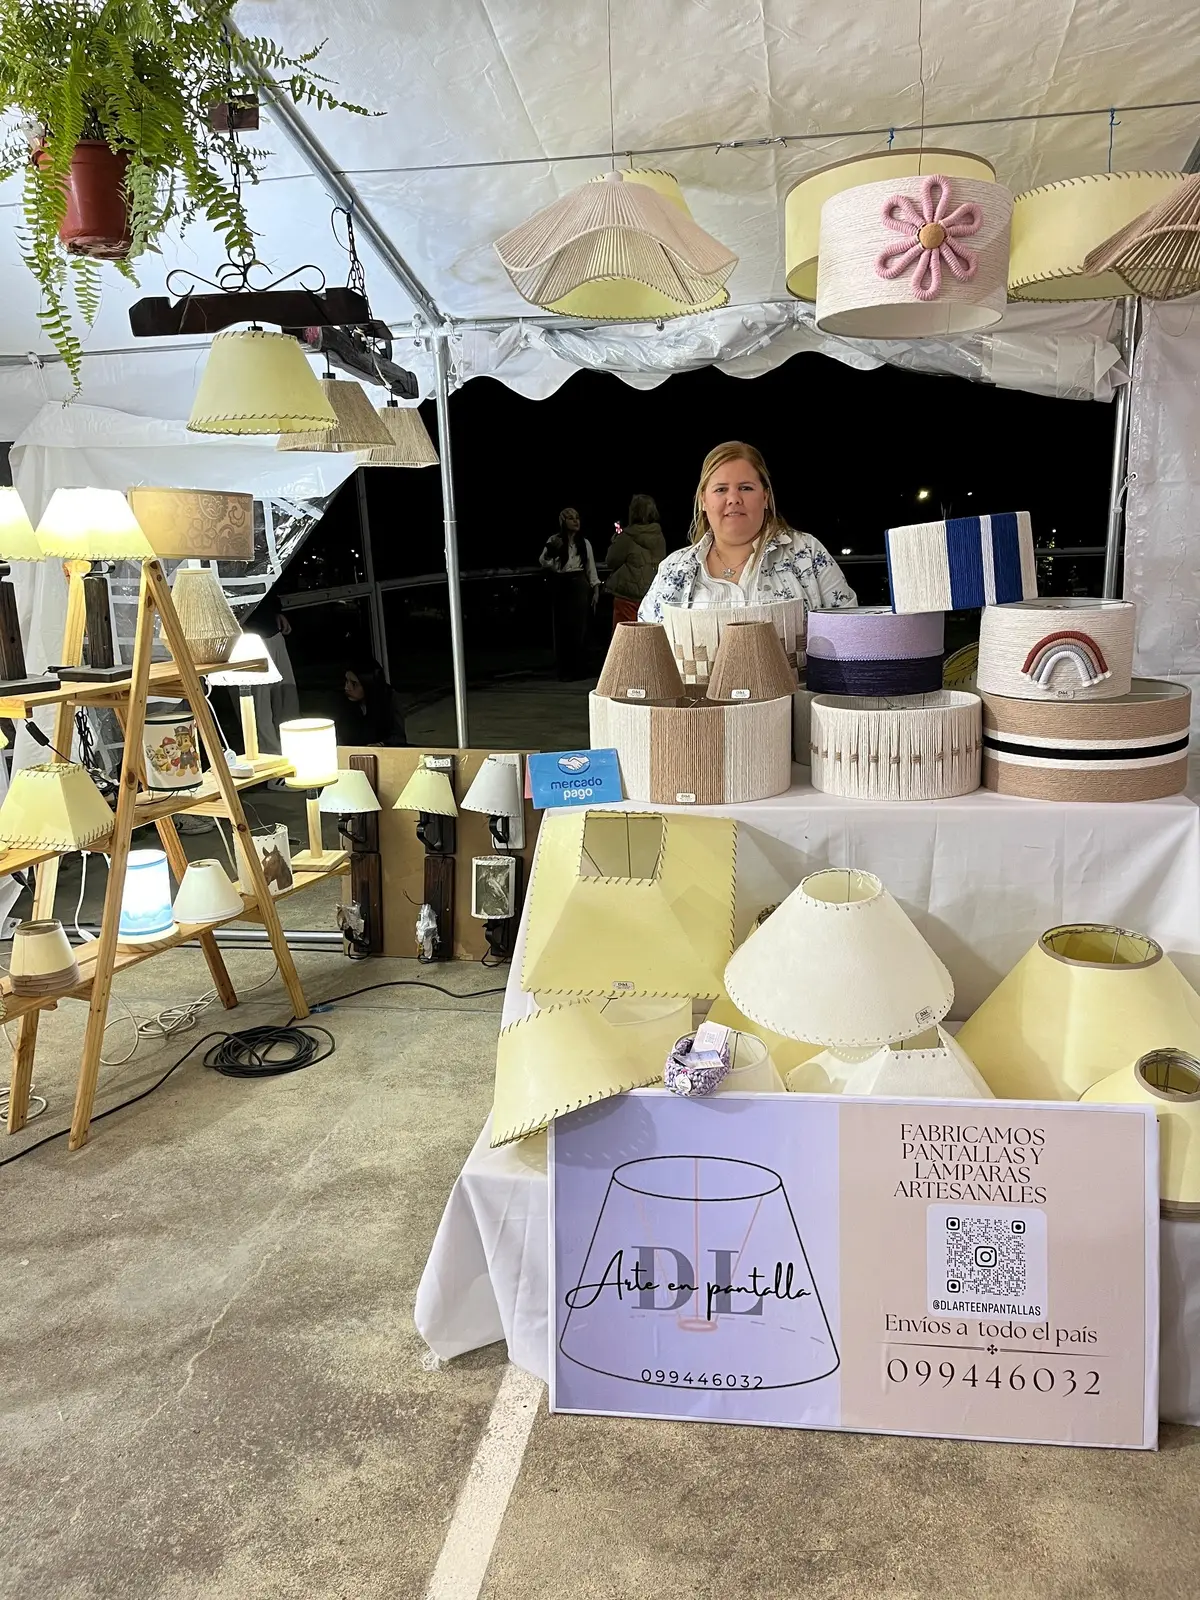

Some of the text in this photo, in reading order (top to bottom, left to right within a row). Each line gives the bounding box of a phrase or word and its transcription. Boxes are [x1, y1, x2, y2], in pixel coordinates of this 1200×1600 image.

[550, 776, 603, 790] mercado
[563, 787, 593, 800] pago
[900, 1123, 1046, 1146] FABRICAMOS
[902, 1143, 1044, 1165] PANTALLAS Y
[915, 1160, 1031, 1184] LÁMPARAS
[893, 1181, 1047, 1204] ARTESANALES
[565, 1249, 812, 1321] Arte en pantalla
[932, 1299, 1041, 1317] @DLARTEENPANTALLAS
[885, 1313, 1098, 1347] Envíos a todo el país
[641, 1368, 764, 1389] 099446032
[886, 1358, 1101, 1397] 099446032
